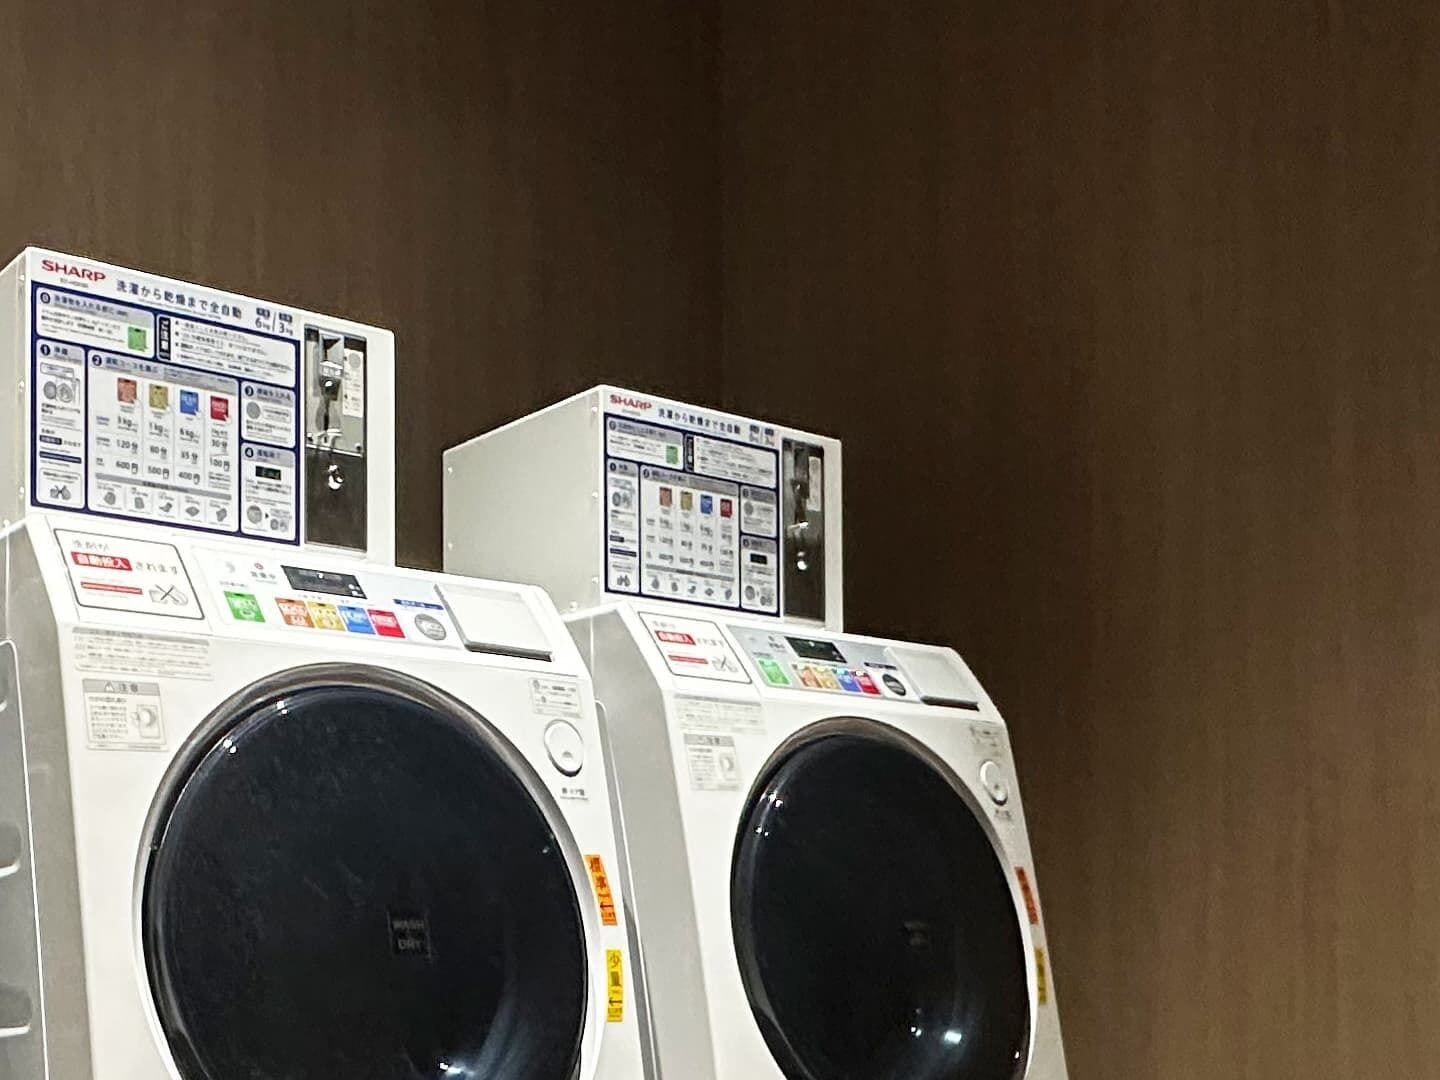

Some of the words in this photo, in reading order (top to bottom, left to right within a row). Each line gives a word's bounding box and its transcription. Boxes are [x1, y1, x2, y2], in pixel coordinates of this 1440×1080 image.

[41, 259, 106, 282] SHARP
[116, 279, 242, 319] 洗濯から乾燥まで全自動
[610, 394, 652, 410] SHARP
